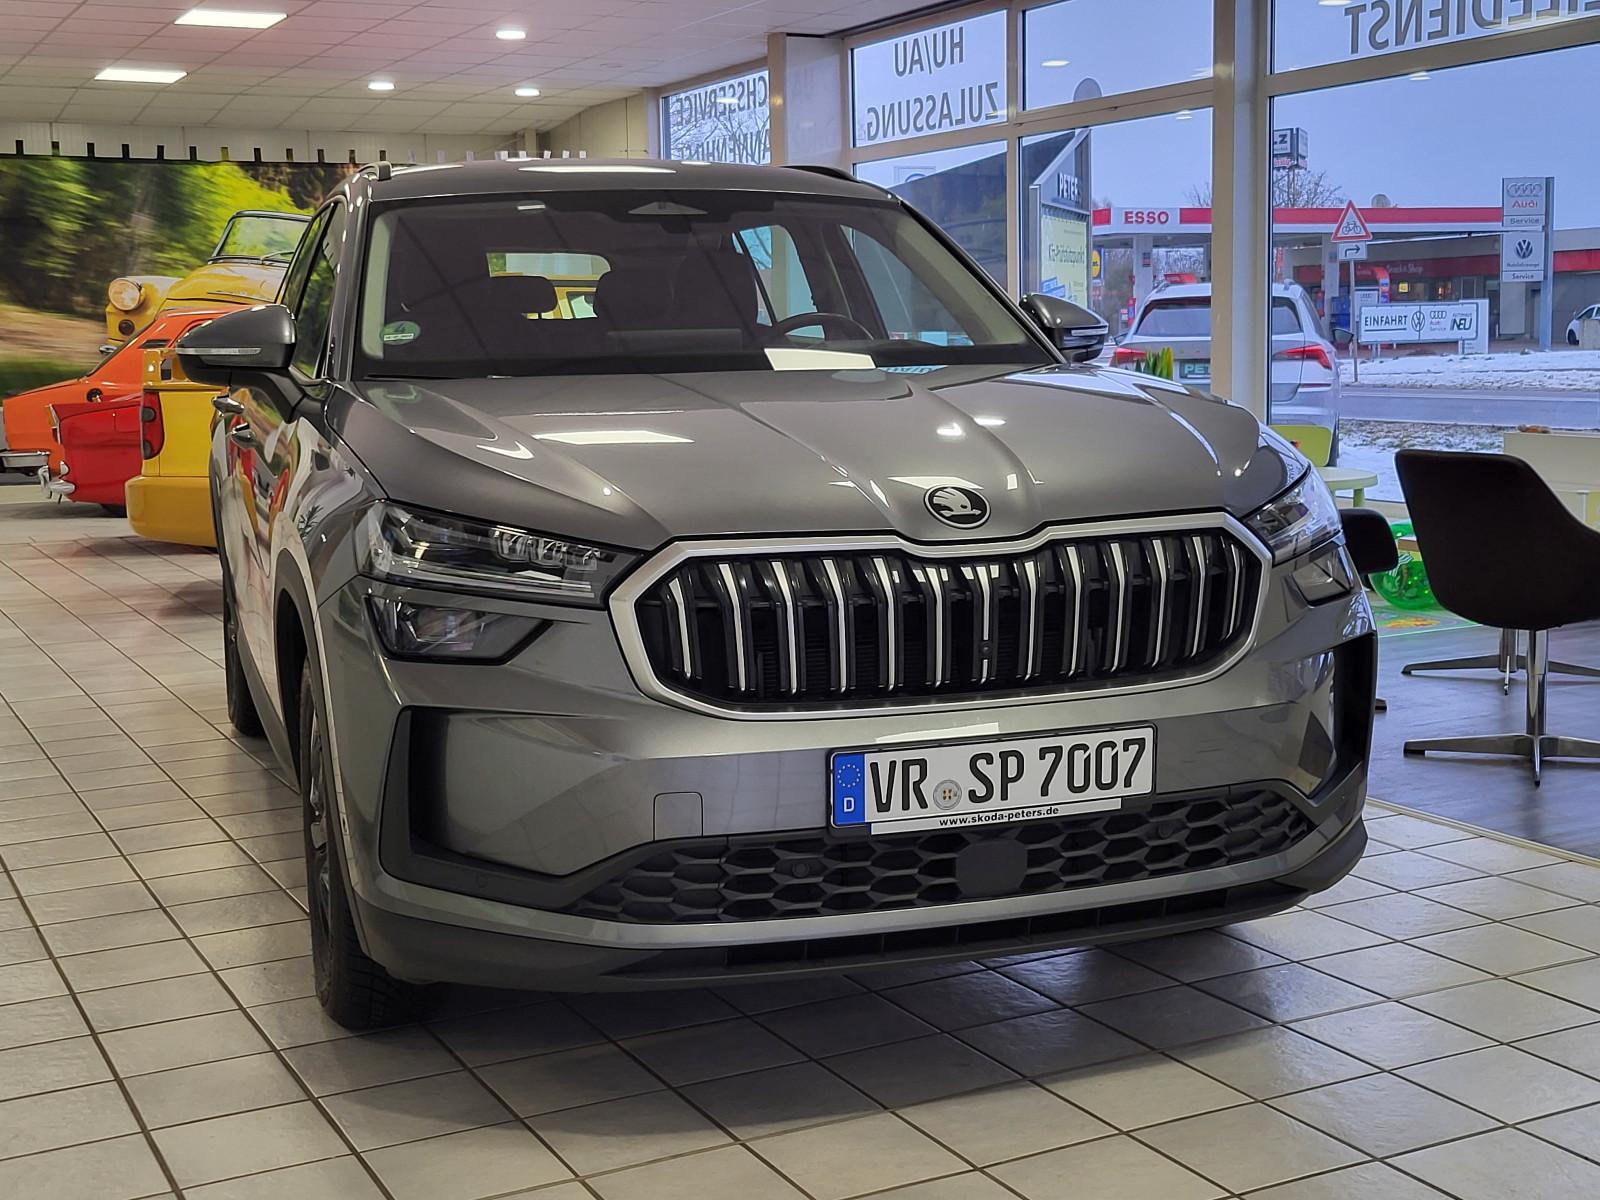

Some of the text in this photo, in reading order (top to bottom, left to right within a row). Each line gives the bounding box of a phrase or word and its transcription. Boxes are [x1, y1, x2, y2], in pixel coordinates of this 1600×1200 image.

[1511, 200, 1538, 208] Audi
[1123, 211, 1169, 225] ESSO
[1510, 217, 1540, 225] Service
[1364, 315, 1408, 327] EINFAHRT
[1450, 318, 1473, 331] NEU
[870, 737, 1146, 813] VR SP 7007
[843, 797, 855, 812] D
[939, 805, 1059, 827] www.skoda-peters.de
